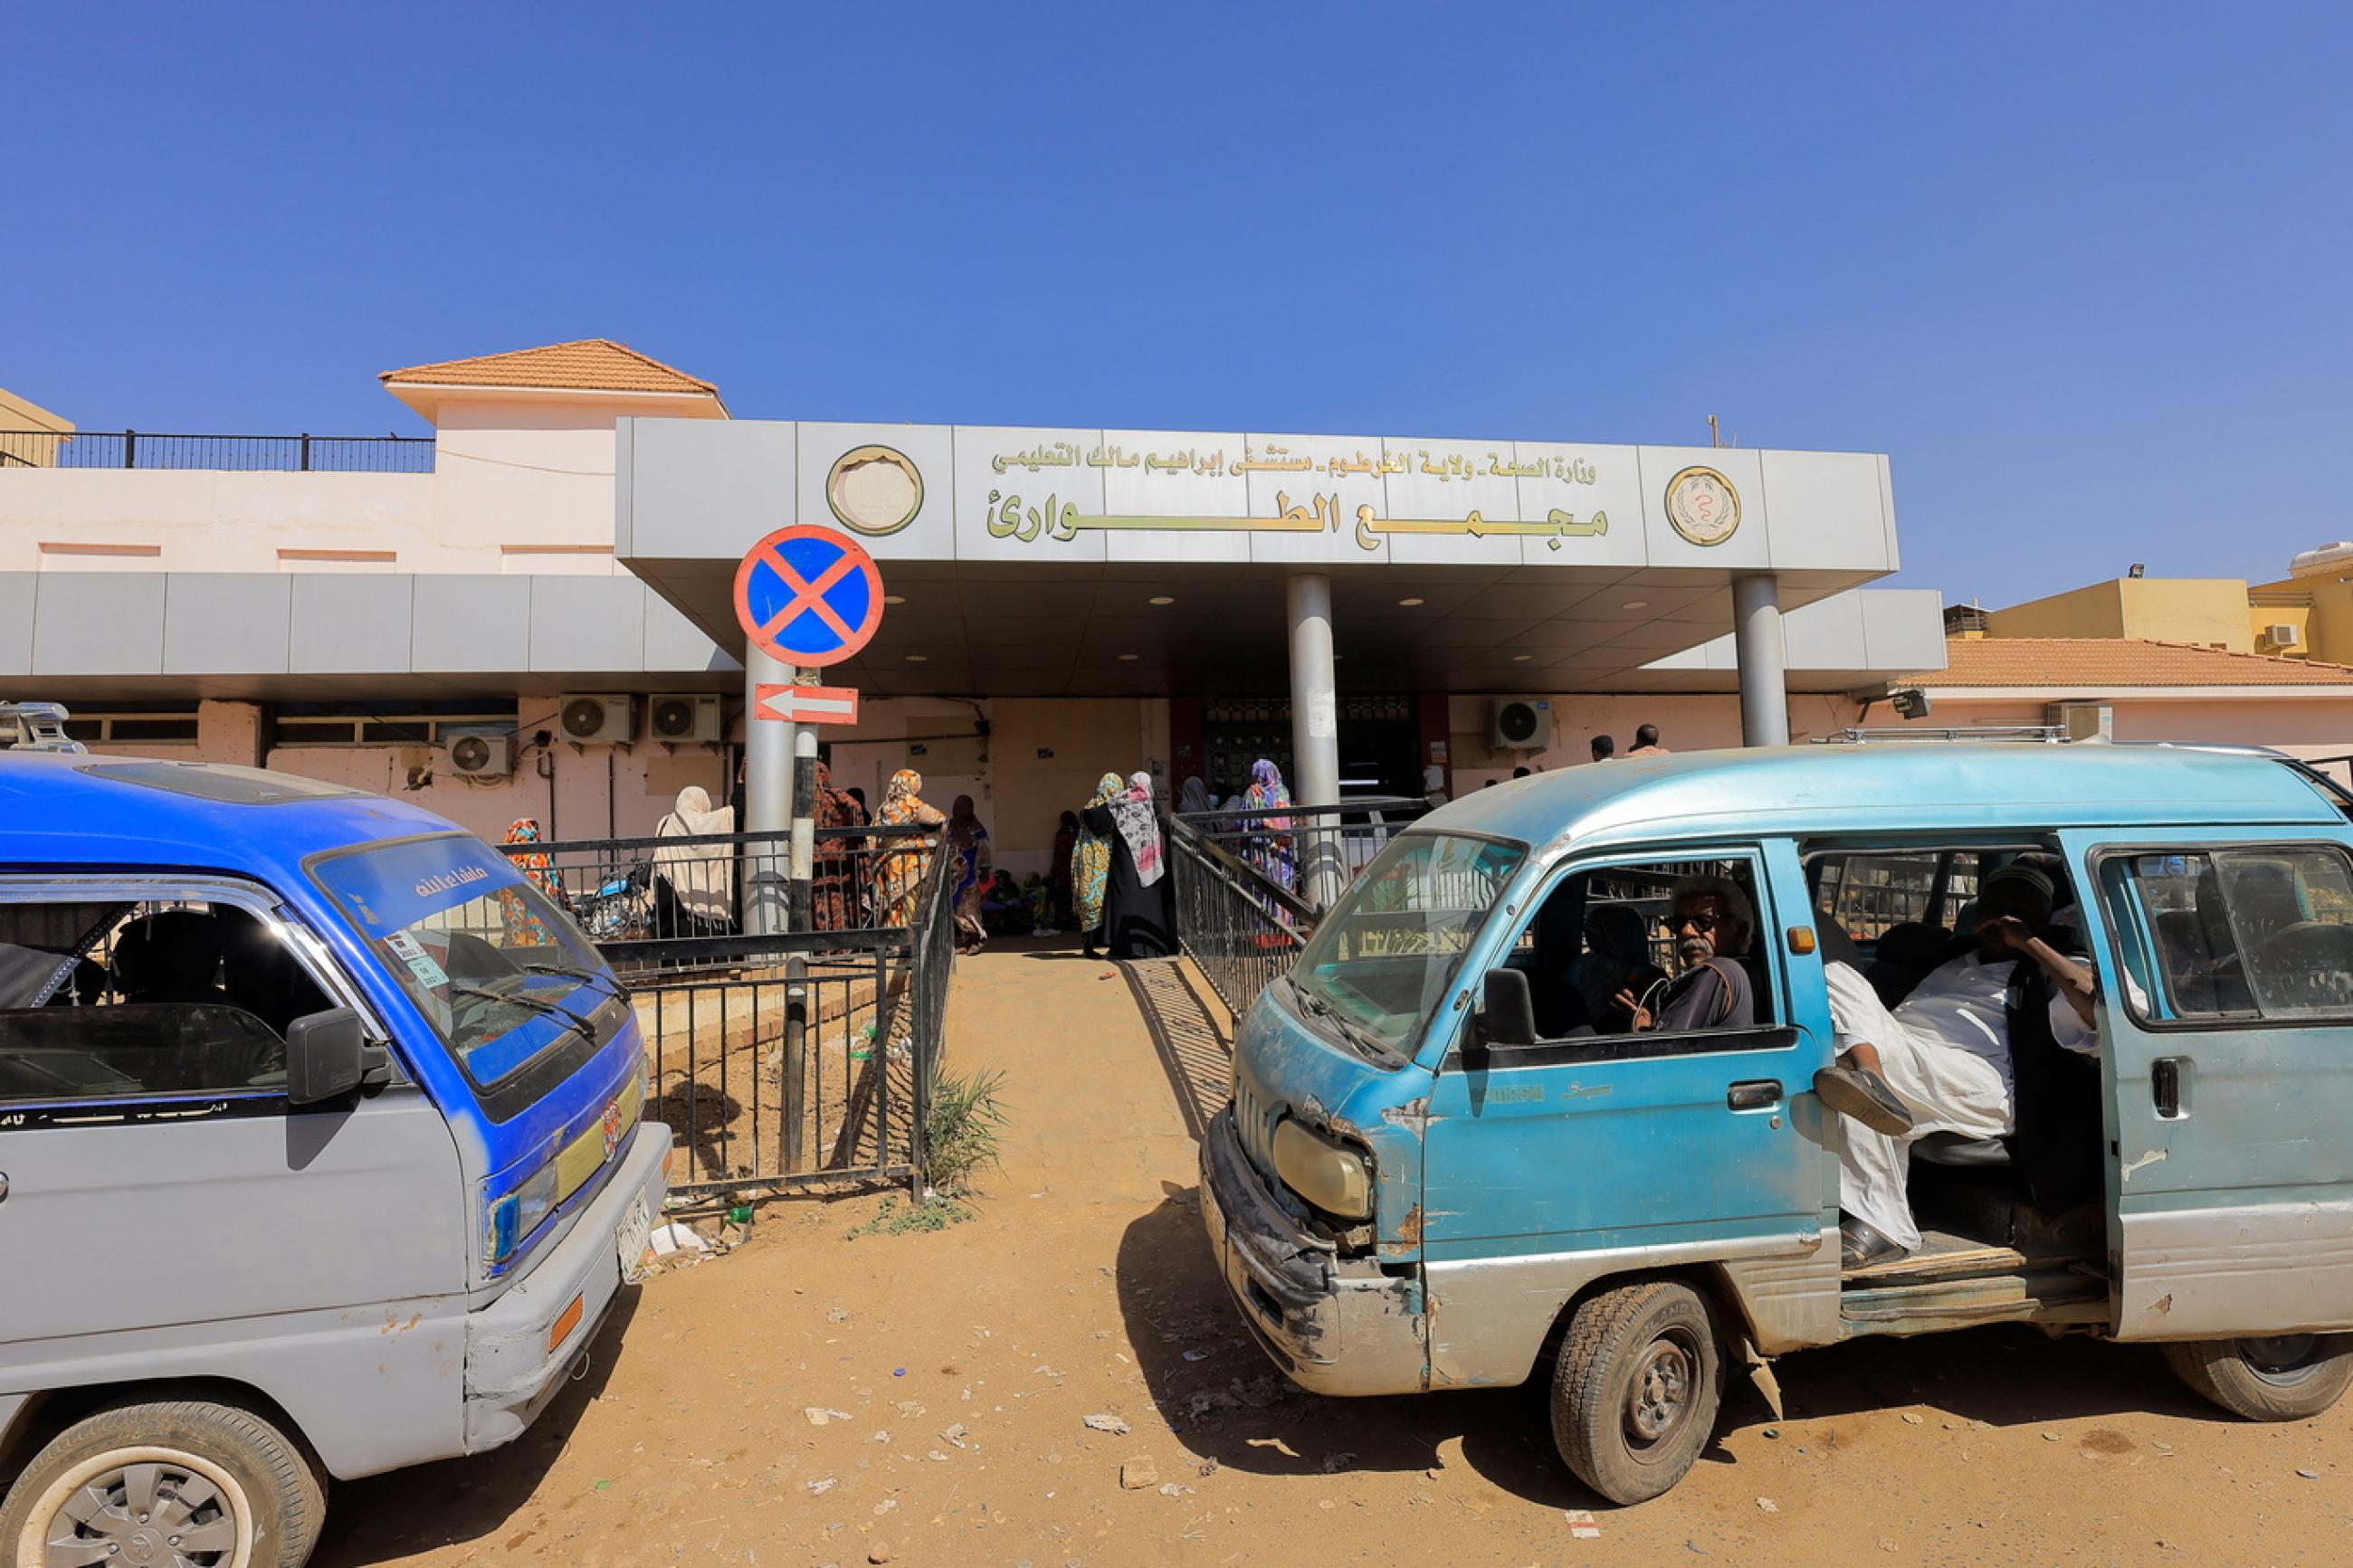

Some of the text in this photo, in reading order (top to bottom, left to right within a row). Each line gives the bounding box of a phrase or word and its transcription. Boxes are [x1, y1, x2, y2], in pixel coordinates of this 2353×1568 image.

[1086, 445, 1140, 468] مالك
[1229, 442, 1312, 477] مستشفى
[1329, 450, 1412, 479] الخرطوم
[1418, 450, 1474, 482] ولاية
[1488, 451, 1551, 478] الصحة
[1555, 456, 1597, 485] وزارة
[1355, 503, 1608, 550] مجمع
